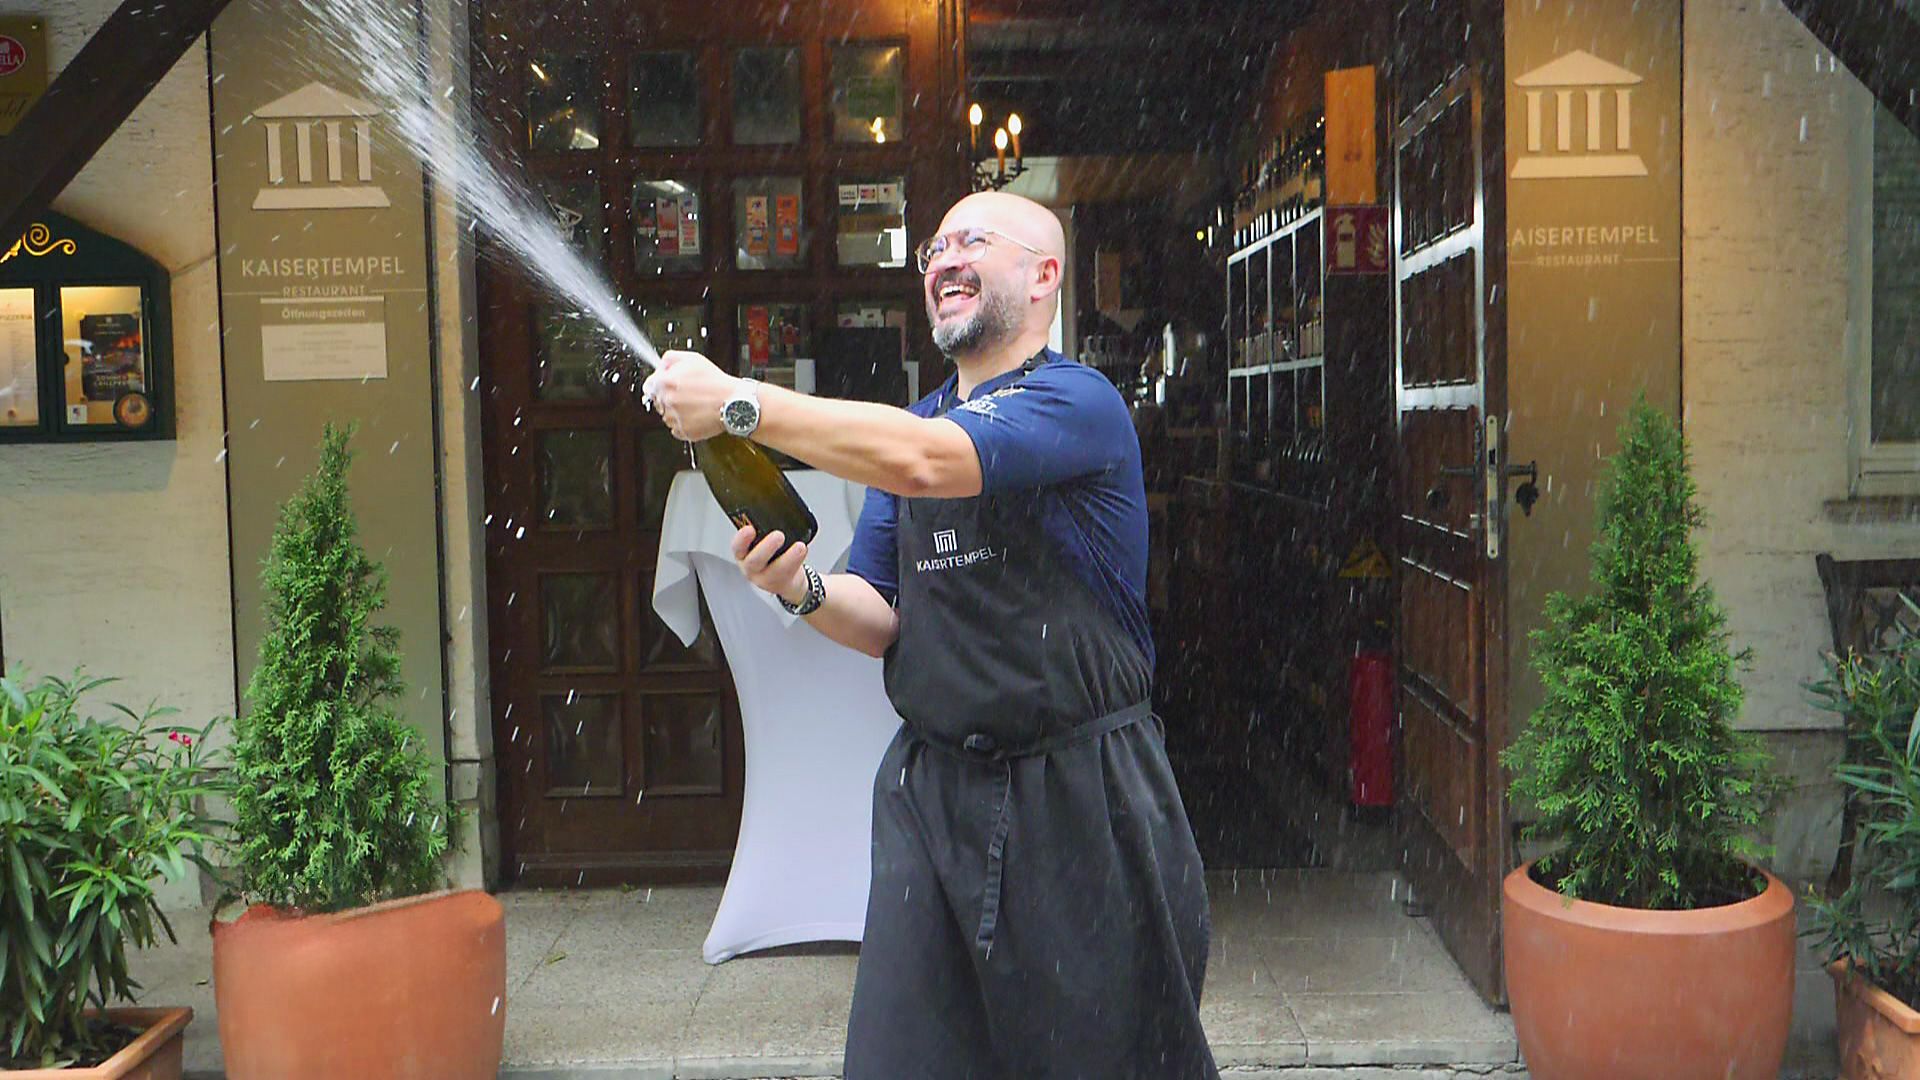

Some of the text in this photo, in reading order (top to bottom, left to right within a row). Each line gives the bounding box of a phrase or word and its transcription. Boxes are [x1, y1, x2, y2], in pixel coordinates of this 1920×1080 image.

[1507, 226, 1659, 247] AISERTEMPEL
[241, 256, 404, 277] KAISERTEMPEL
[1536, 254, 1620, 267] RESTAURANT
[282, 285, 366, 298] RESTAURANT
[281, 307, 366, 320] Öffnungszeiten
